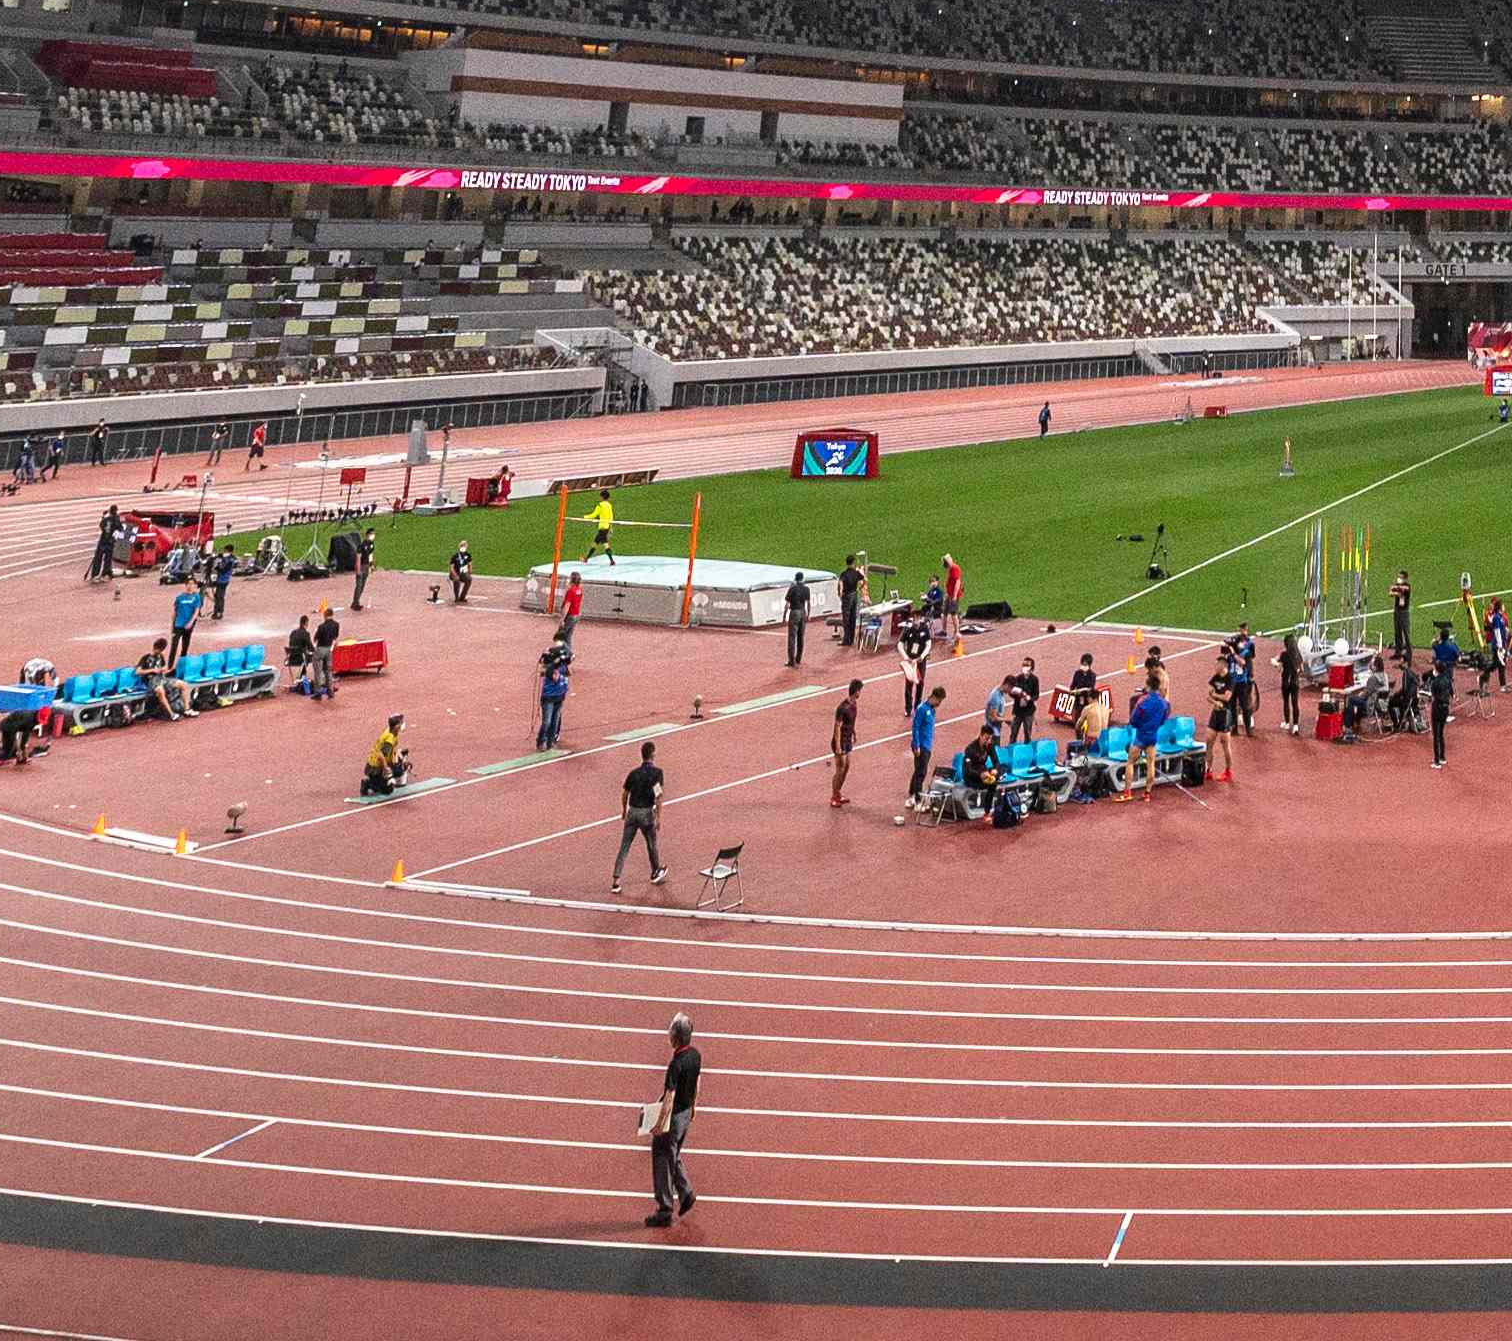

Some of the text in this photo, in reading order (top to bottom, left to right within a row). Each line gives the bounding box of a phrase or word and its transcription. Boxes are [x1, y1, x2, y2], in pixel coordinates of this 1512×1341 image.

[460, 171, 502, 189] READY
[502, 172, 548, 190] STEADY
[549, 174, 586, 191] TOKYO
[1044, 190, 1074, 204] READY
[1074, 191, 1110, 205] STEADY
[1110, 192, 1140, 205] TOKYO
[1426, 265, 1466, 276] GATE 1
[1056, 693, 1076, 715] 100
